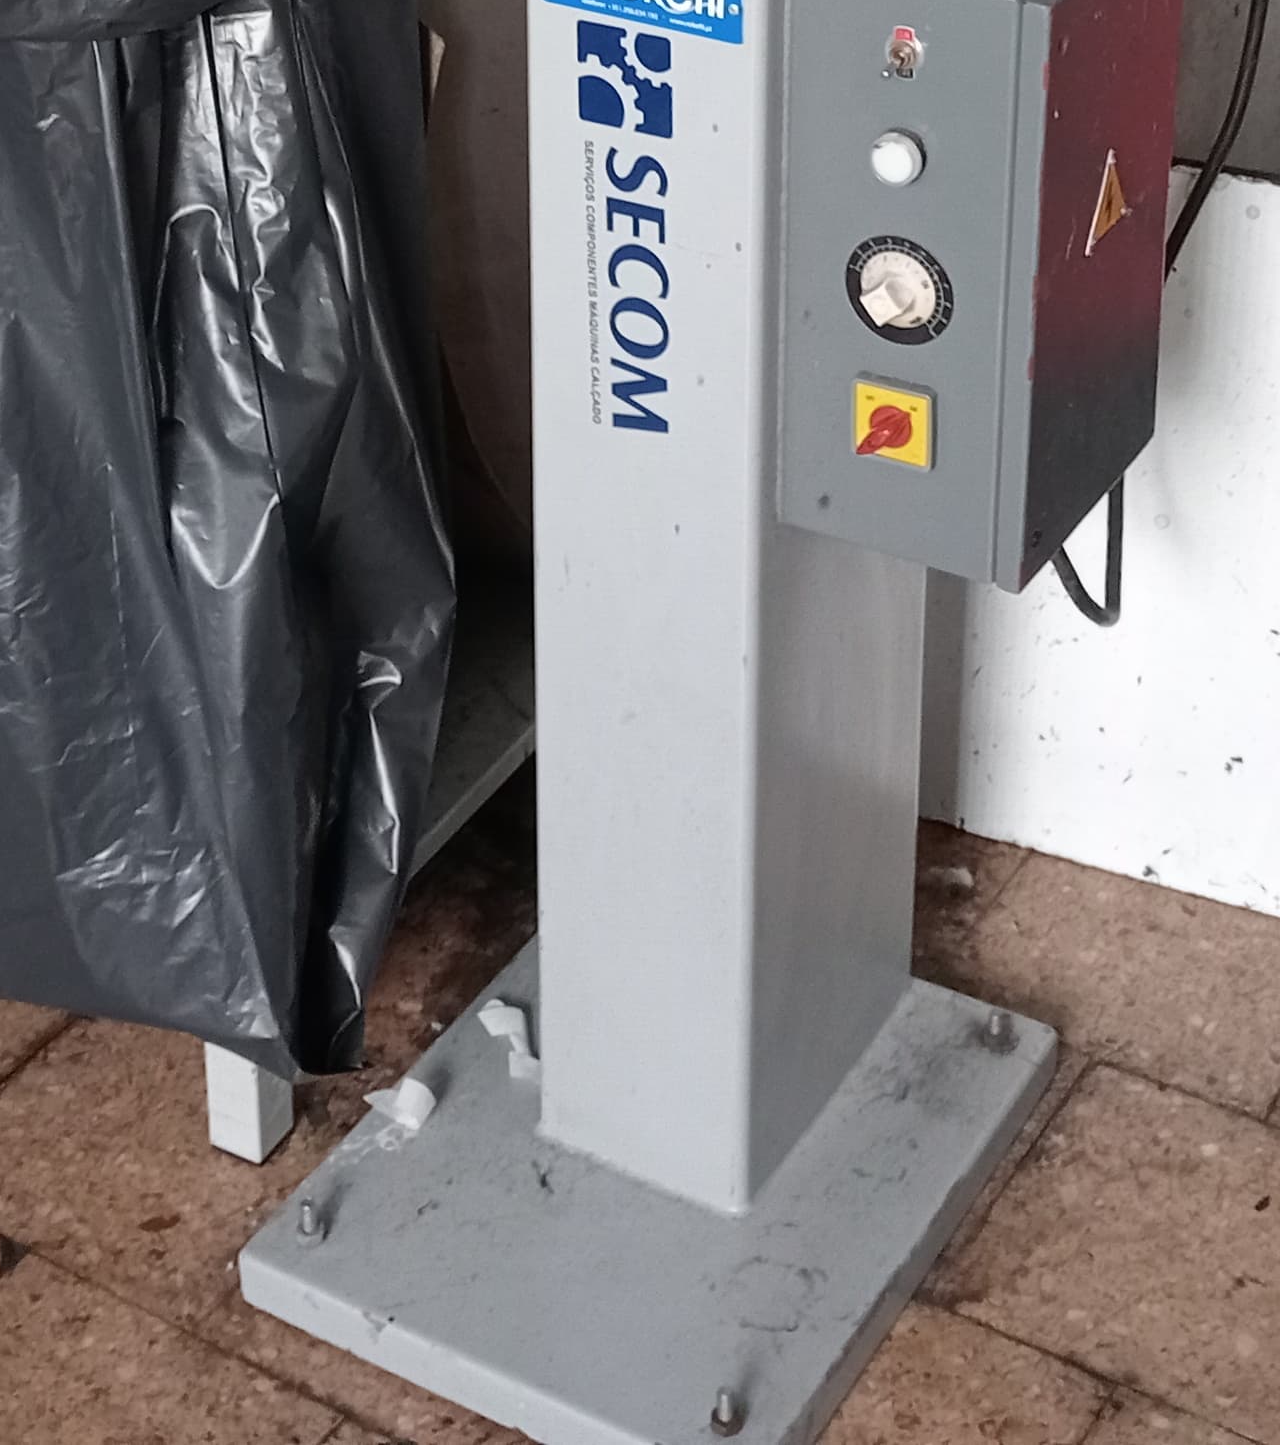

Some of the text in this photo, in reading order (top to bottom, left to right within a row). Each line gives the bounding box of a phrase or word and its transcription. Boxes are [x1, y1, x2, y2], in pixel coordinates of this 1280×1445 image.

[583, 139, 596, 203] SERVIÇOS
[585, 204, 598, 298] COMPONENTES
[605, 145, 669, 434] SECOM
[590, 366, 602, 425] CALÇADO
